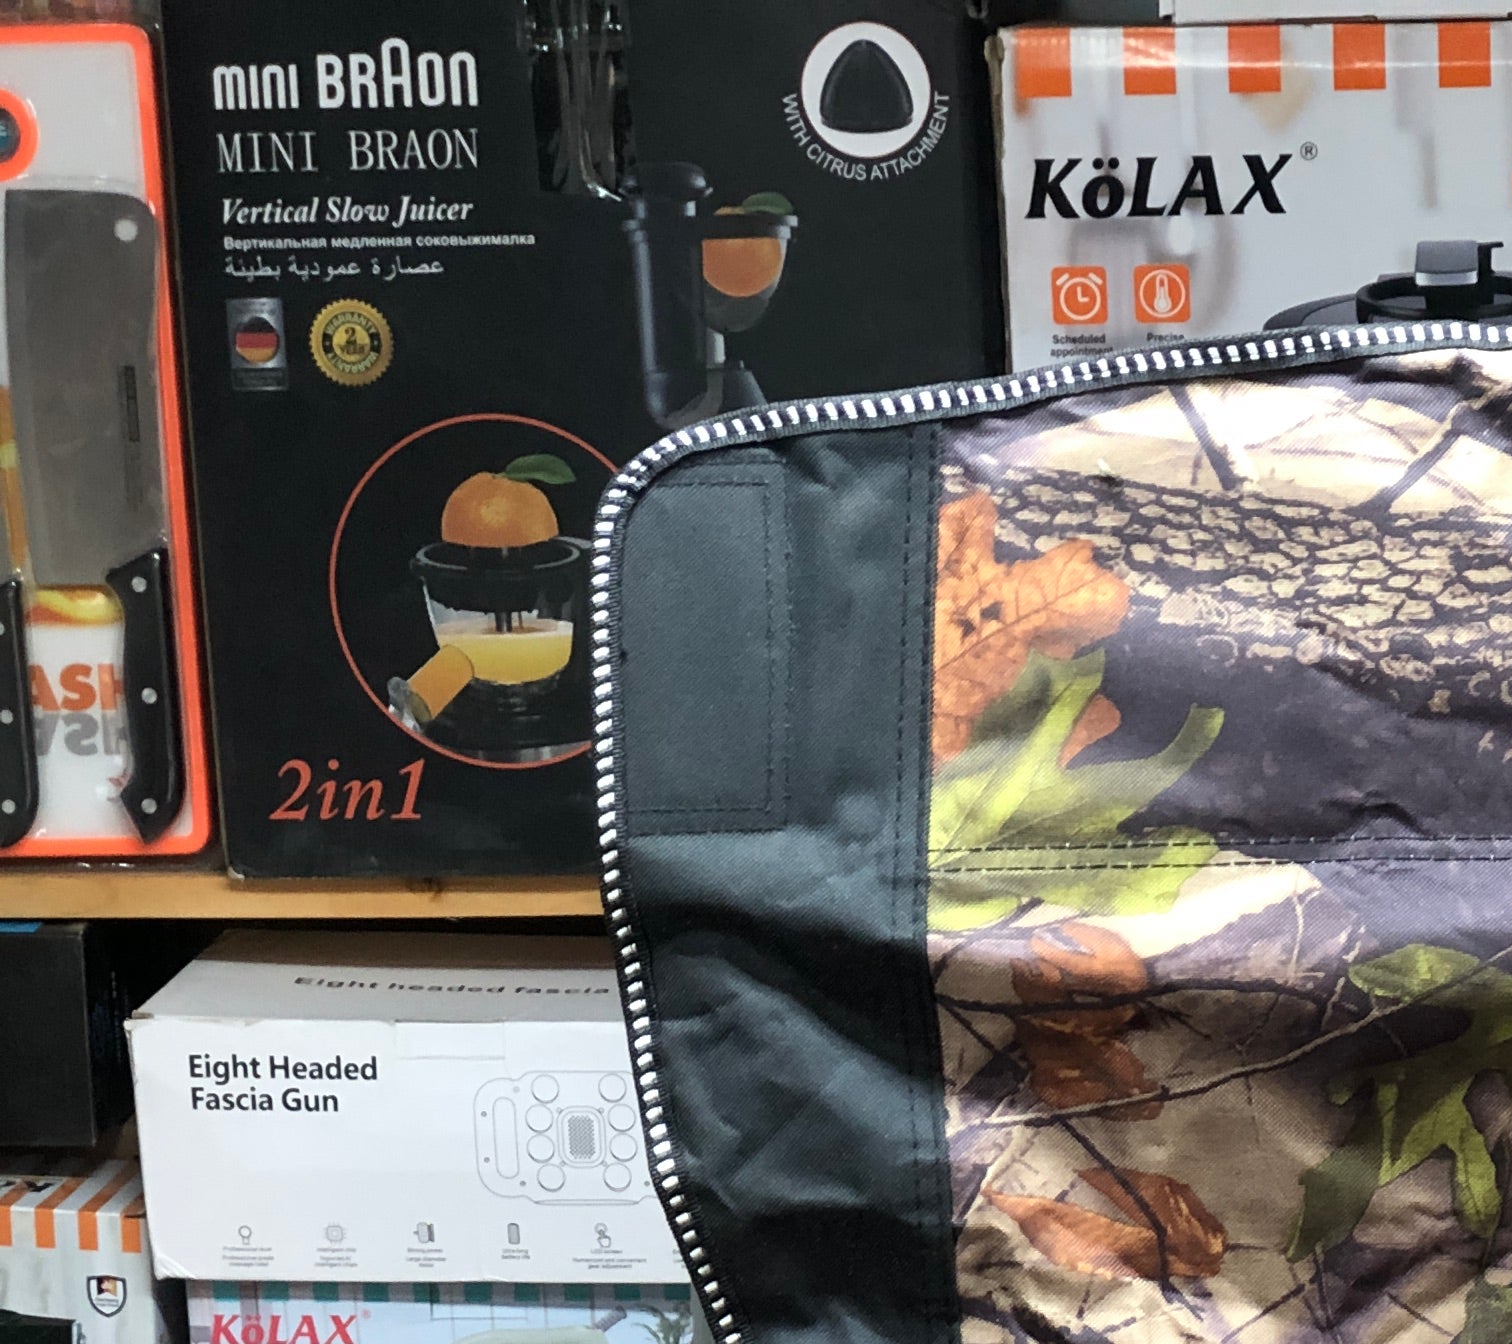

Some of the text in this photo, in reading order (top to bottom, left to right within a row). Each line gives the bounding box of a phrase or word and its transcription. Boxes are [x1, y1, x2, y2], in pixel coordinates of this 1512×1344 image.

[216, 128, 479, 173] MINI BRAON
[782, 90, 950, 181] WITH CITRUS ATTACHMENT
[222, 195, 474, 228] Vertical Slow Juicer
[223, 233, 536, 251] Вертикальная медленная соковыжималка
[1052, 334, 1106, 345] Scheduled
[269, 757, 426, 820] 2in1
[188, 1054, 378, 1084] Eight Headed
[191, 1087, 339, 1112] Fascia Gun
